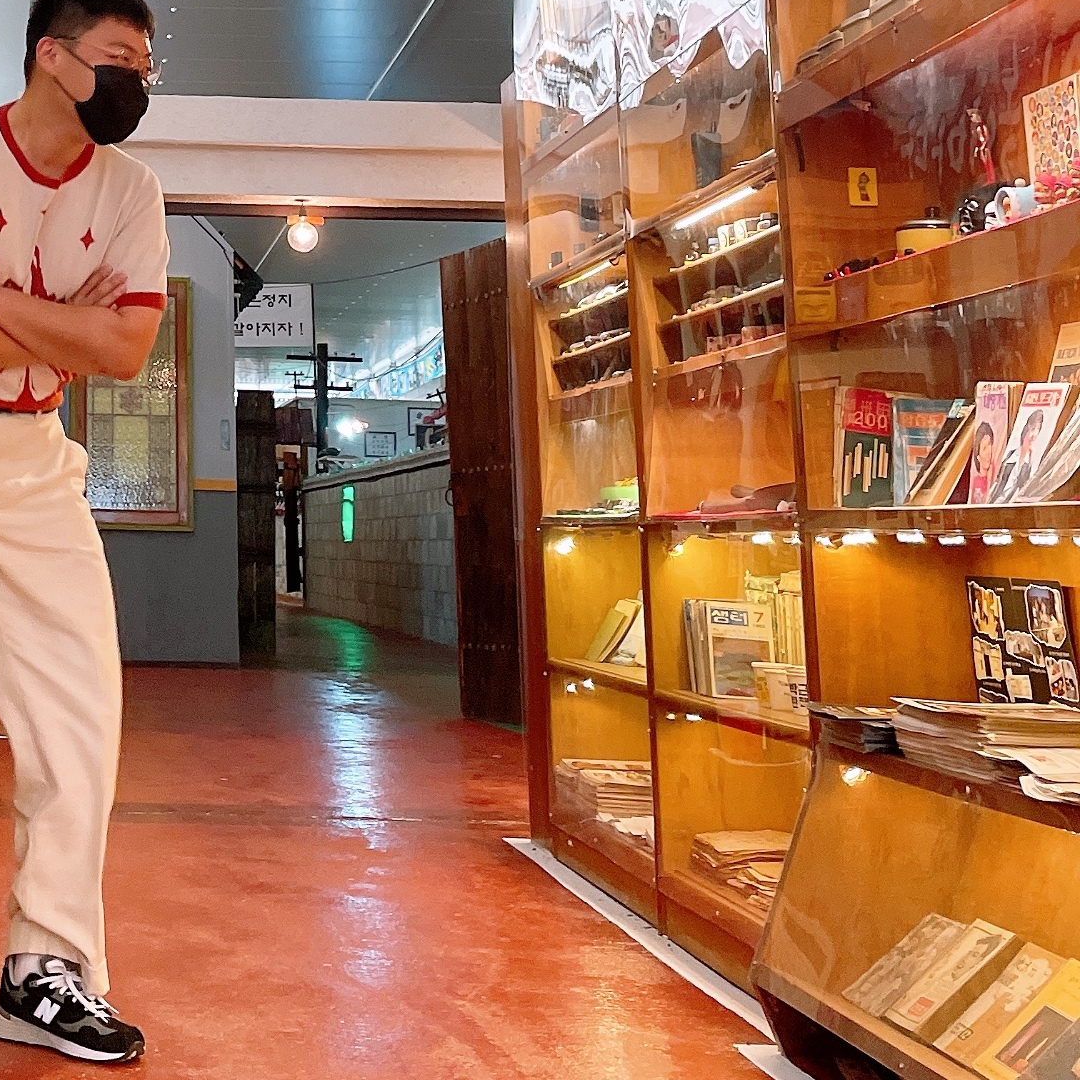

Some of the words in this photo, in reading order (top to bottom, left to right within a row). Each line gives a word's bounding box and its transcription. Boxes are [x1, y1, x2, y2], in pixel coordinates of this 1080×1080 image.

[711, 609, 749, 626] 샘터
[753, 611, 764, 623] 7
[33, 996, 62, 1025] N
